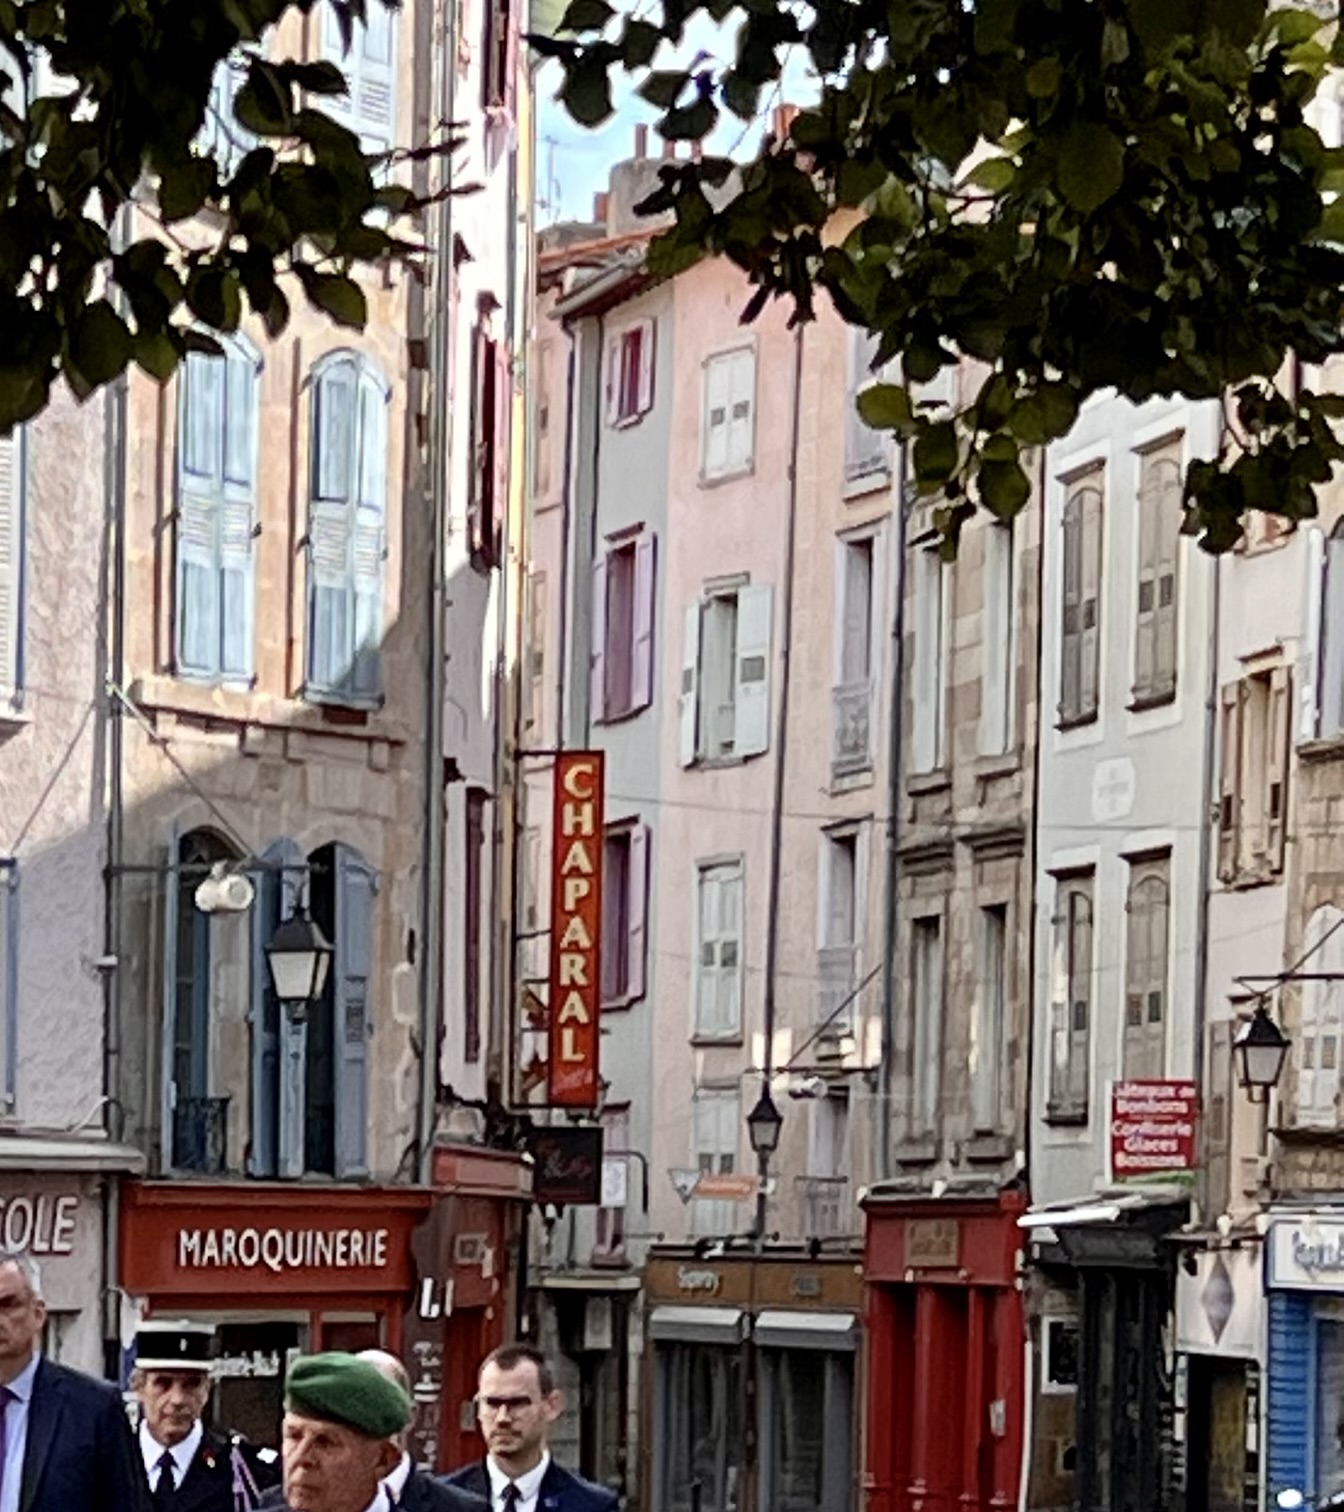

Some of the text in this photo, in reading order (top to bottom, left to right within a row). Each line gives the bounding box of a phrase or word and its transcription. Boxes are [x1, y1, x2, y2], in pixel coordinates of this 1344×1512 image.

[558, 762, 596, 1063] CHAPARAL
[1124, 1136, 1179, 1152] Glaces
[178, 1228, 389, 1272] MAROQUINERIE
